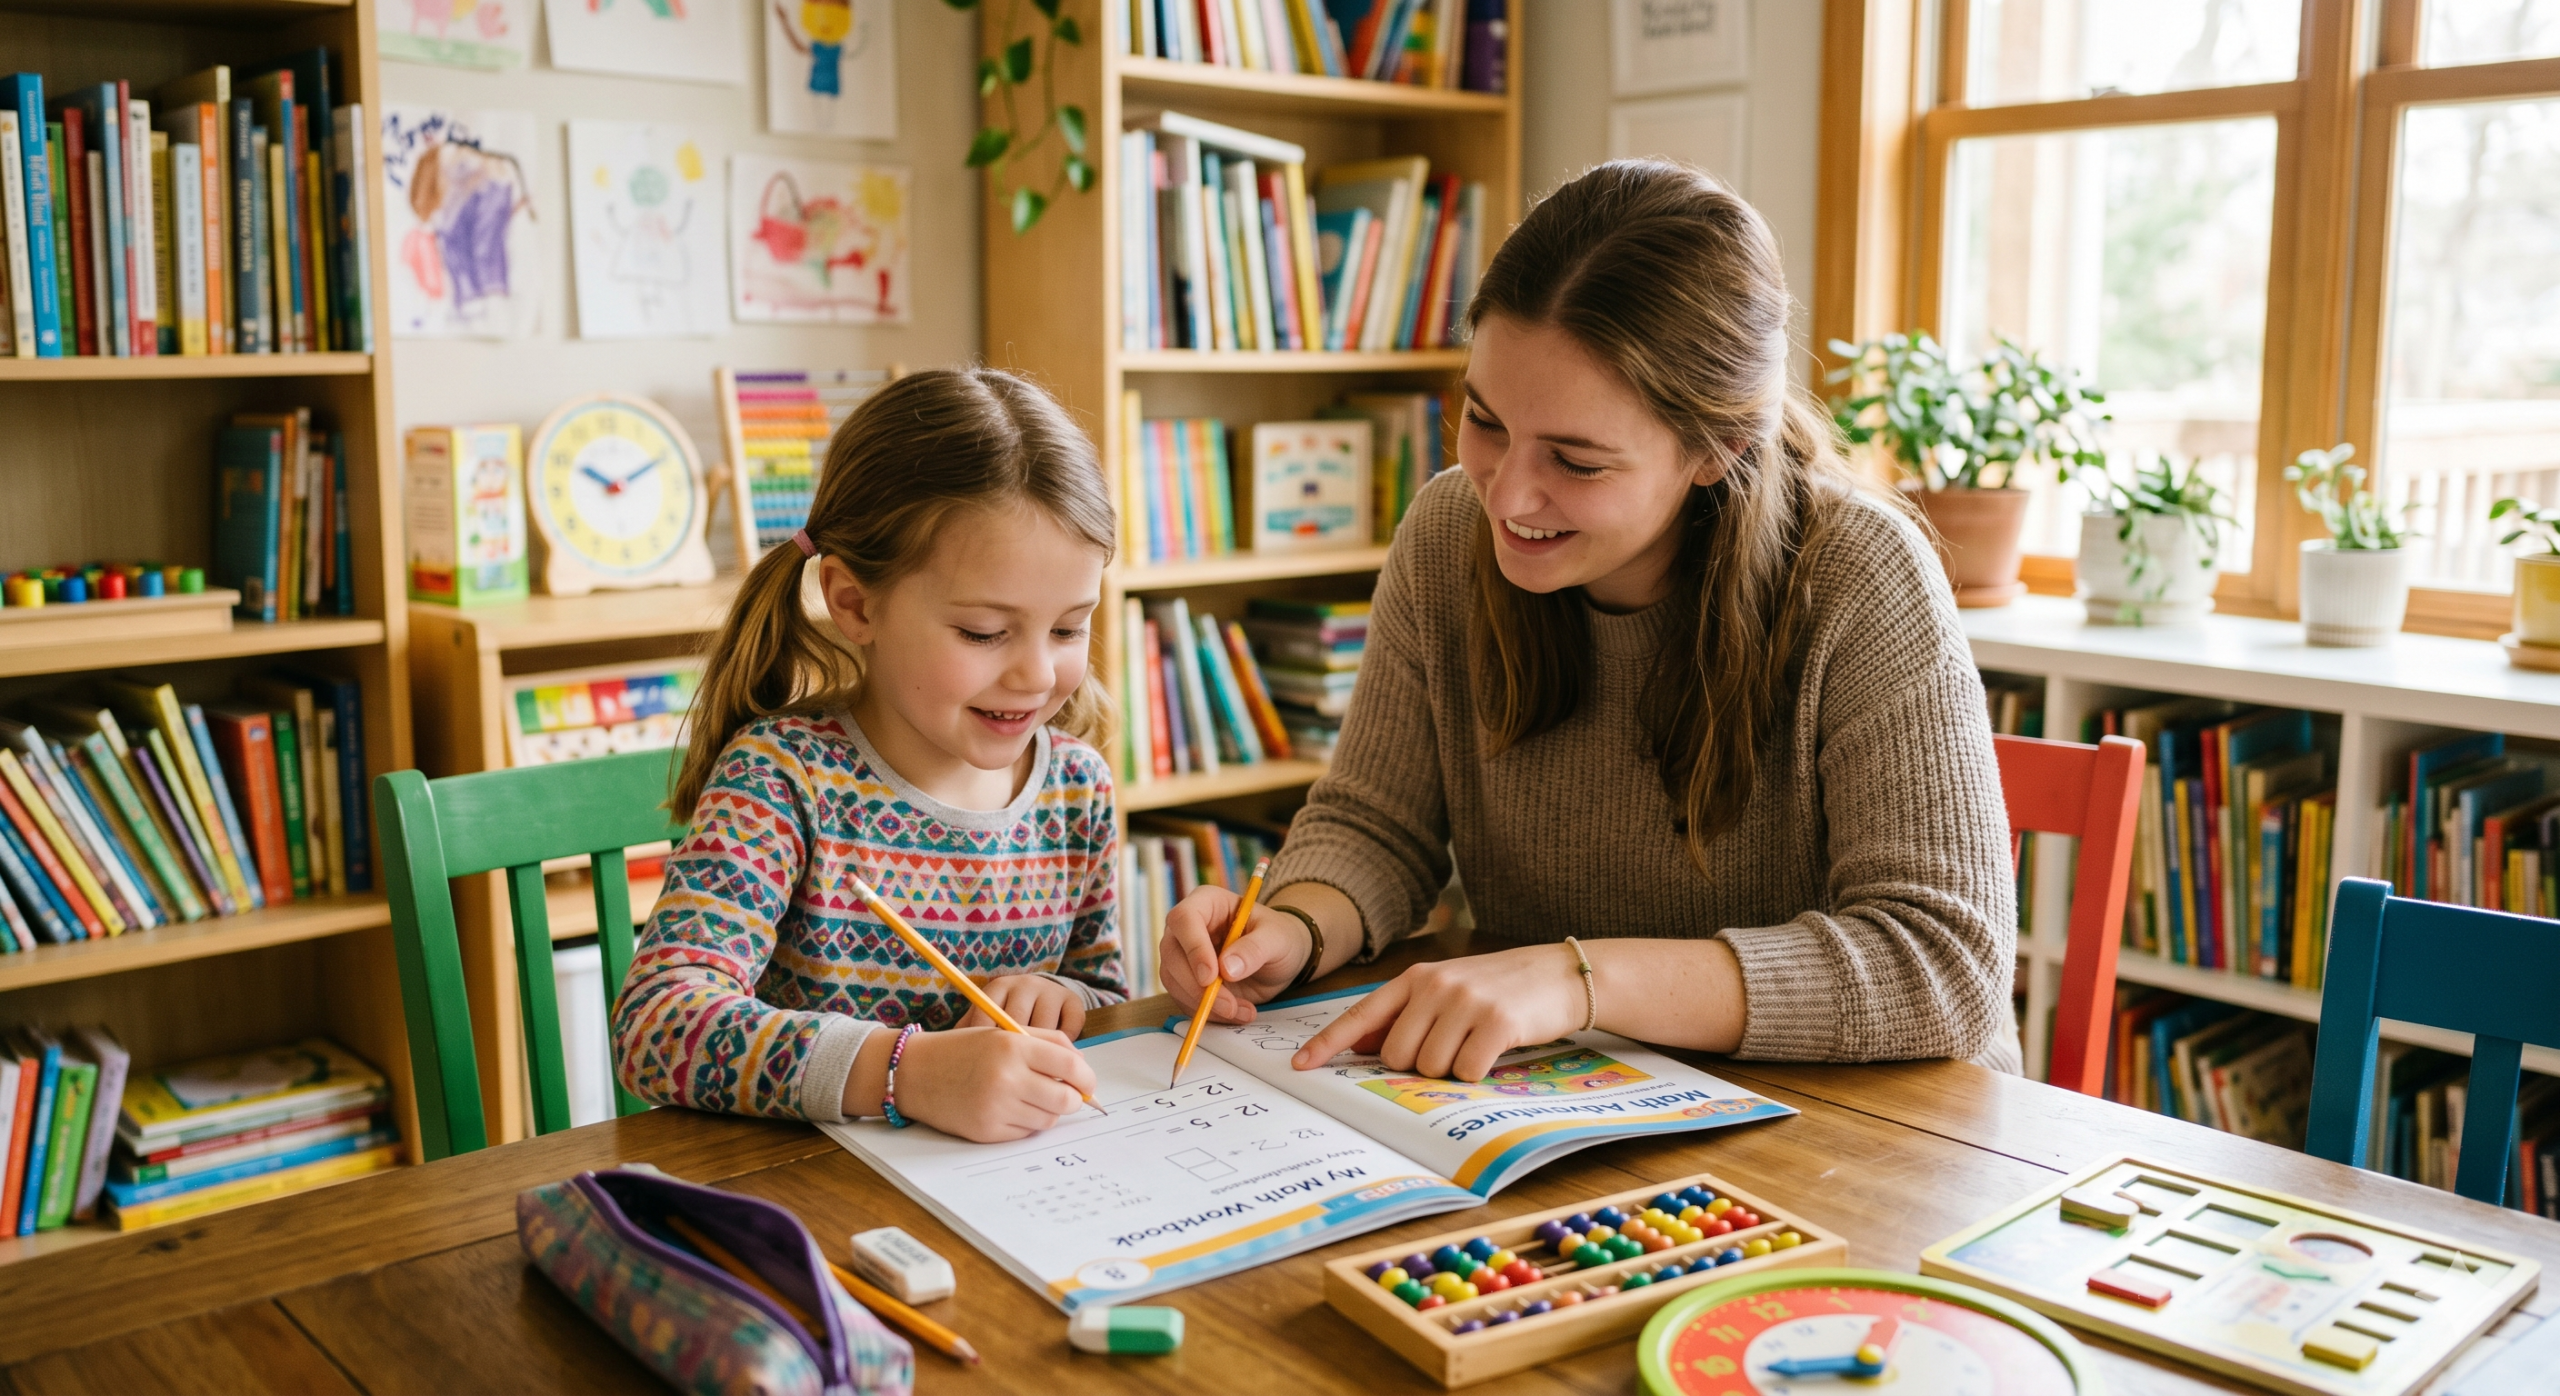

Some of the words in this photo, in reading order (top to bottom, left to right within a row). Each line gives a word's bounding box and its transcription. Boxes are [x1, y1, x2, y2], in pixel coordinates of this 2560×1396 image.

[1199, 1082, 1234, 1096] 12
[1154, 1098, 1177, 1109] 5
[1632, 1089, 1713, 1109] Math
[1234, 1102, 1269, 1117] 12
[1190, 1118, 1213, 1130] 5
[1055, 1153, 1088, 1168] 13
[1327, 1166, 1367, 1182] My
[1254, 1177, 1325, 1203] Math
[1108, 1201, 1255, 1248] Workbook
[1749, 1301, 1794, 1321] 12
[1827, 1296, 1853, 1311] 1
[1902, 1303, 1935, 1321] 2
[1706, 1324, 1746, 1344] 11
[1692, 1355, 1738, 1379] 10
